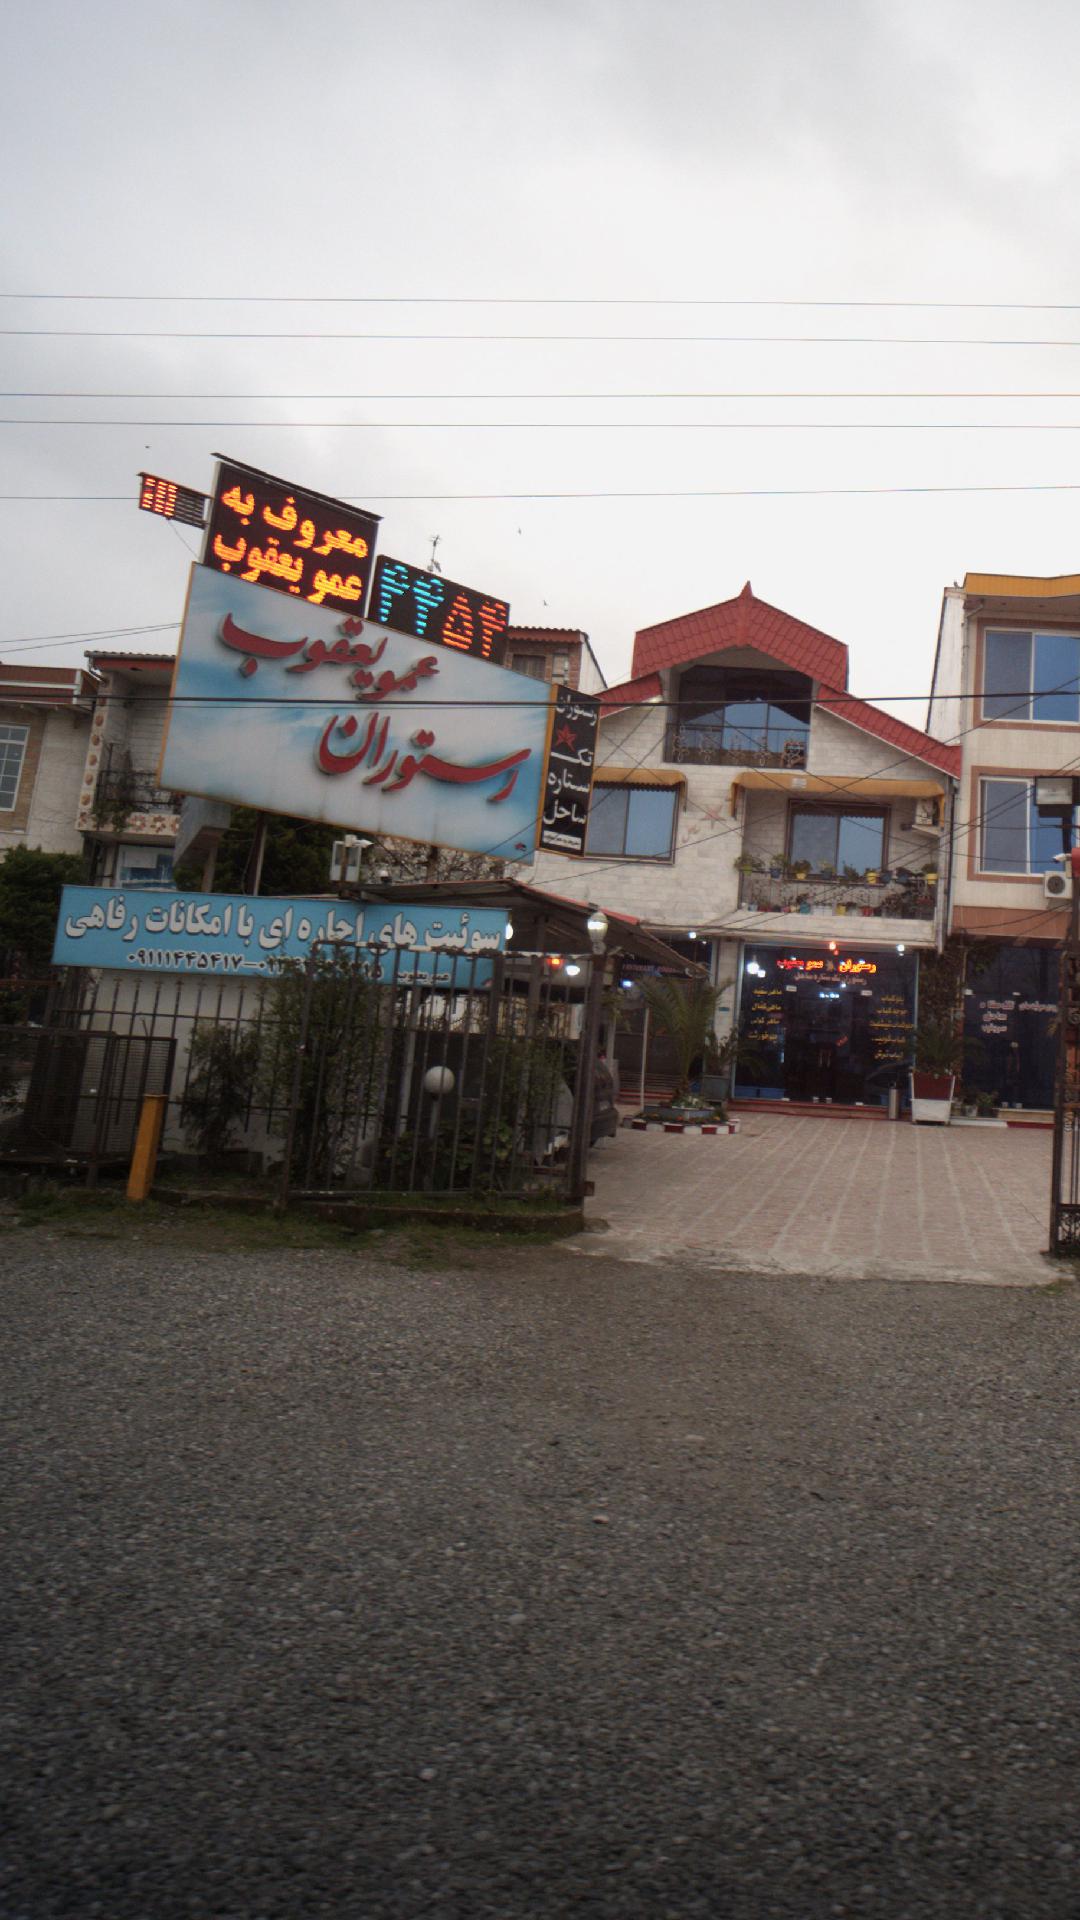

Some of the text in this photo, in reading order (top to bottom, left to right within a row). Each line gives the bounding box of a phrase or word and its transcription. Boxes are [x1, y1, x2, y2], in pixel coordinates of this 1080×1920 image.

[222, 486, 368, 557] معروف به
[214, 534, 362, 604] عمو یعقوب
[219, 612, 439, 701] عمو یعقوب
[555, 694, 598, 727] رستوران
[316, 711, 532, 803] رستوران
[550, 748, 594, 767] تک
[547, 768, 591, 794] ستاره
[543, 799, 587, 825] ساحل
[65, 895, 138, 942] رفاهی
[145, 900, 233, 936] امکانات
[237, 904, 254, 946] با
[259, 906, 293, 949] ای
[369, 912, 418, 954] های
[839, 959, 877, 973] رستوران
